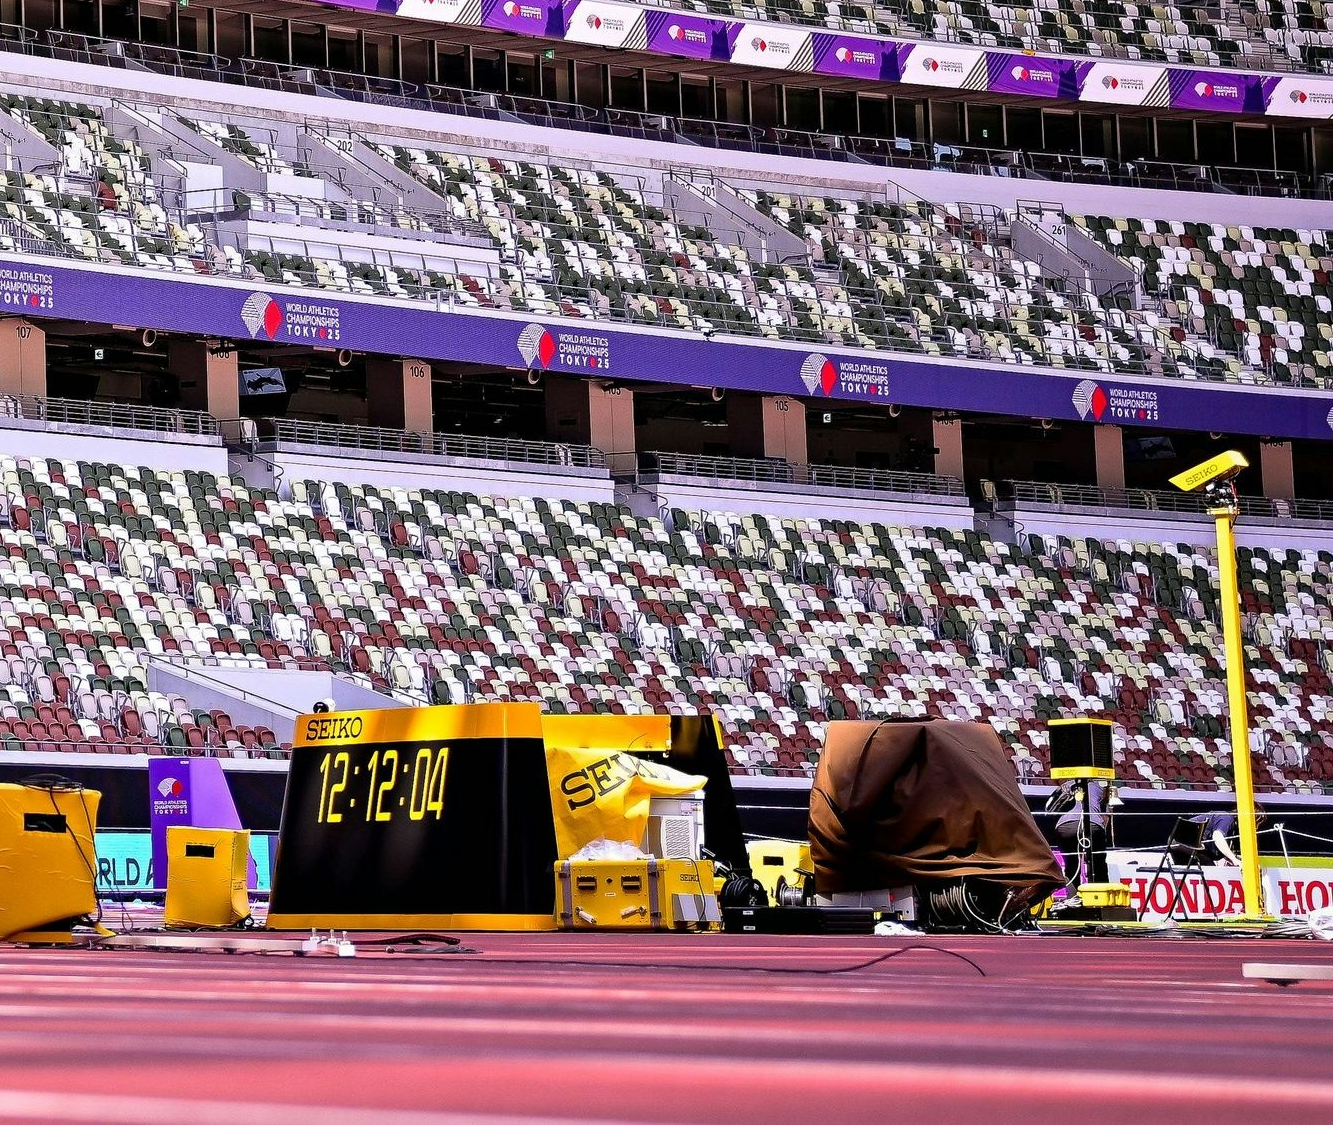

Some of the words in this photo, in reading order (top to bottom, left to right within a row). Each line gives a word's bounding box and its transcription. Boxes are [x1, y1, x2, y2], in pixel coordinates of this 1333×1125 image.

[337, 139, 353, 153] 202
[701, 185, 715, 197] 201
[1052, 225, 1066, 236] 261
[19, 272, 52, 285] ATHLETICS
[286, 302, 307, 313] WORLD
[308, 306, 339, 317] ATHLETICS
[286, 313, 339, 328] CHAMPIONSHIPS
[16, 326, 31, 339] 107
[558, 333, 578, 343] WORLD
[579, 336, 608, 347] ATHLETICS
[558, 343, 608, 357] CHAMPIONSHIPS
[409, 366, 424, 378] 106
[840, 362, 859, 371] WORLD
[860, 365, 888, 375] ATHLETICS
[840, 372, 888, 385] CHAMPIONSHIPS
[1109, 389, 1127, 397] WORLD
[1129, 391, 1157, 400] ATHLETICS
[774, 400, 789, 412] 105
[1109, 397, 1157, 410] CHAMPIONSHIPS
[1185, 464, 1218, 486] SEIKO
[306, 716, 363, 741] SEIKO
[317, 747, 450, 824] 12:12:04
[98, 858, 140, 886] RLD
[680, 874, 699, 882] SEIKO
[1119, 877, 1245, 914] HONDA
